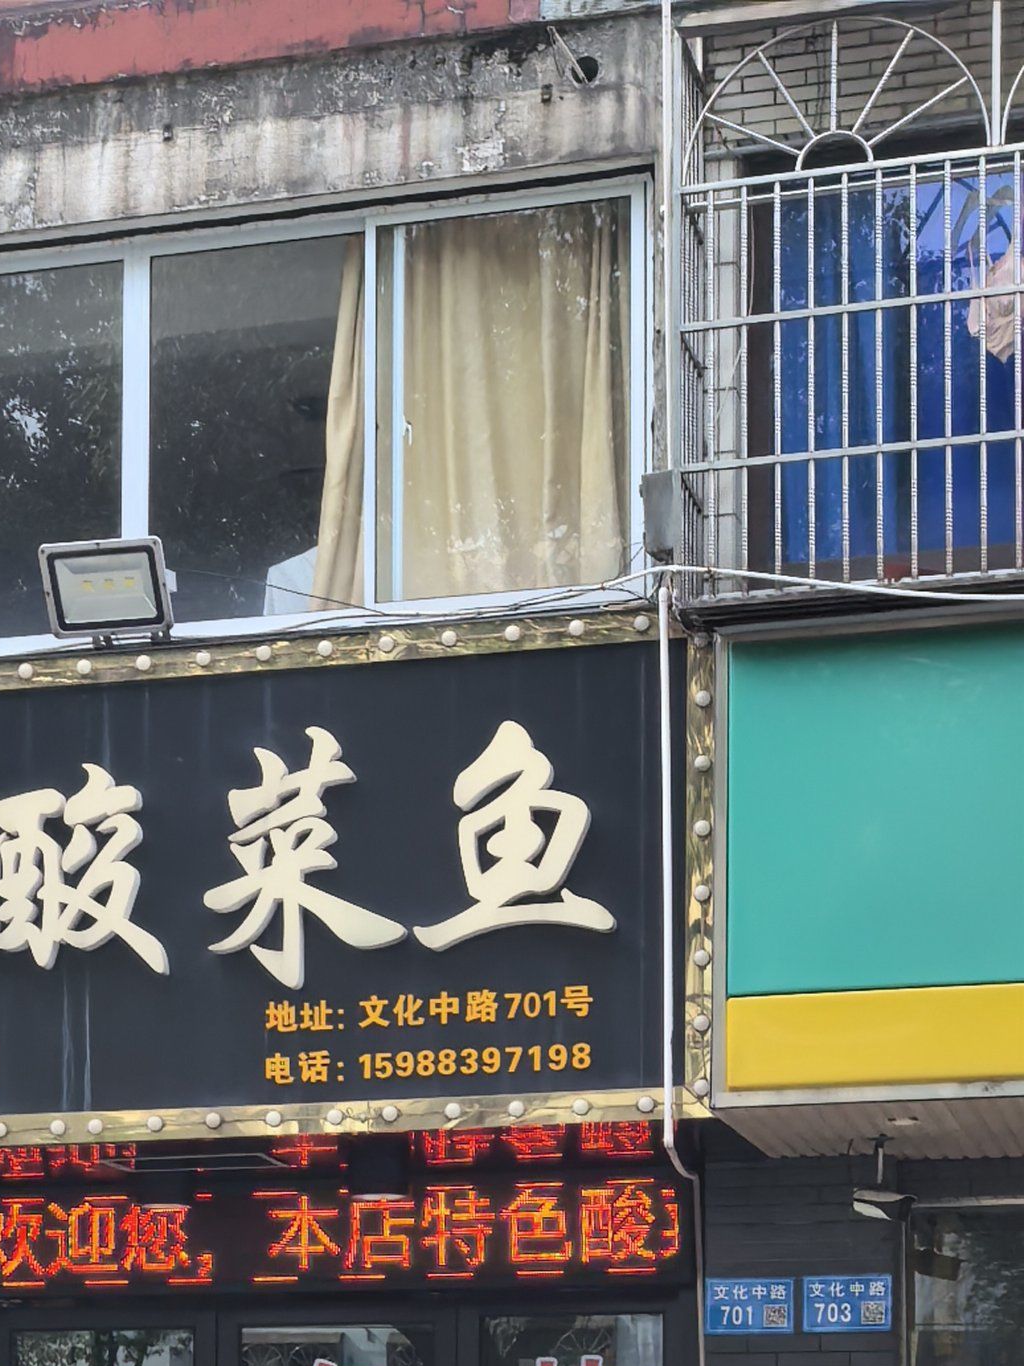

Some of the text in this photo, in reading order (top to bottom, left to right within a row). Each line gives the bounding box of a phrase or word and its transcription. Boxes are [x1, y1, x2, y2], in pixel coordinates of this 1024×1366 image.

[713, 1284, 787, 1301] 文化中路
[808, 1281, 886, 1298] 文化中路
[720, 1305, 753, 1326] 701
[814, 1302, 852, 1324] 703
